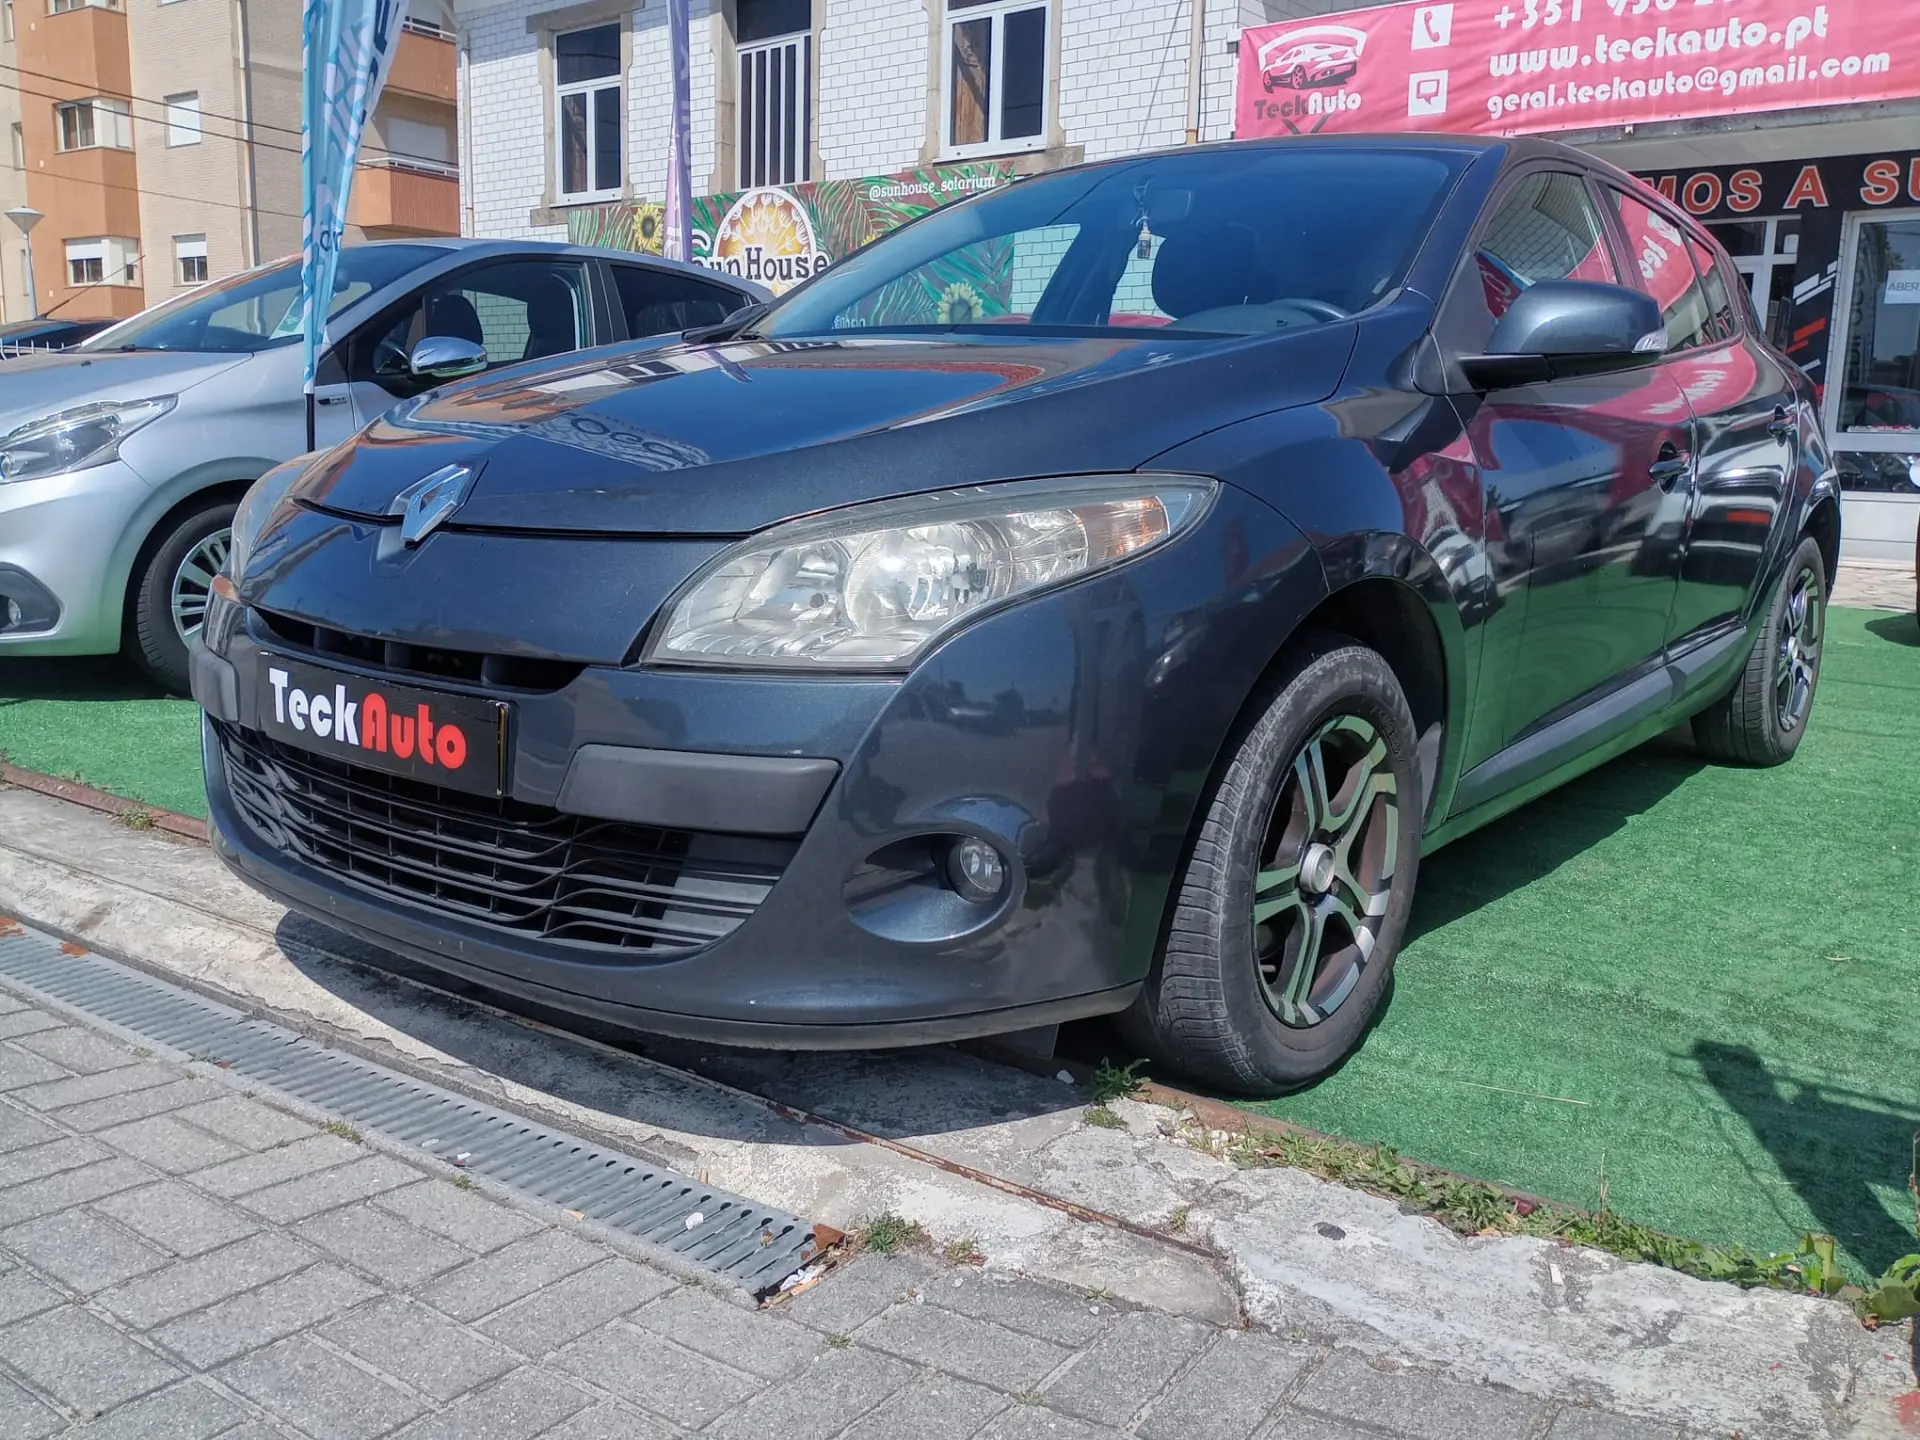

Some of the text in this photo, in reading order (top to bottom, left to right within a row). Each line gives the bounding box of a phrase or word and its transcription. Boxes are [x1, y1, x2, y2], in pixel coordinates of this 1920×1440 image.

[1489, 5, 1829, 77] www.teckauto.pt
[1254, 88, 1362, 120] TeckAuto
[1487, 52, 1890, 120] geral.teckauto@gmail.com
[869, 174, 996, 200] @sunhouse_solarium
[1783, 165, 1829, 209] A
[269, 667, 467, 769] TeckAuto
